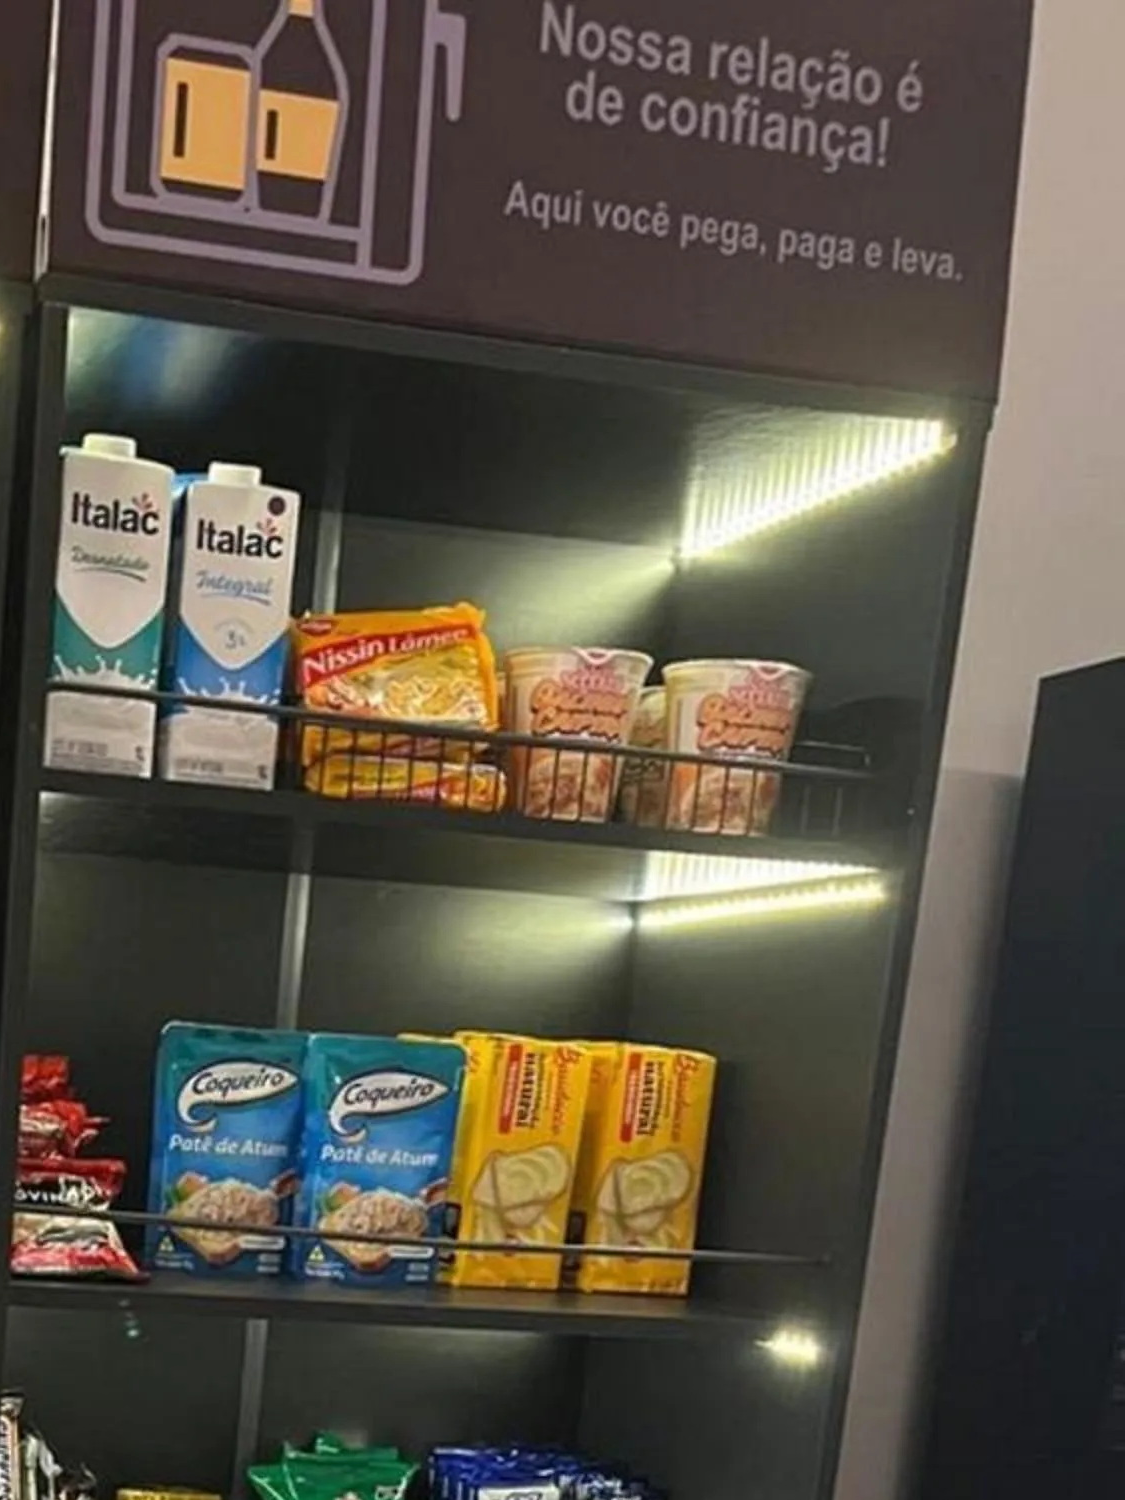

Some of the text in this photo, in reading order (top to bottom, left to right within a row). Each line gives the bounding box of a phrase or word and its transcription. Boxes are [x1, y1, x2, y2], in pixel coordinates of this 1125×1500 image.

[539, 1, 924, 113] Nossa relação é
[565, 70, 892, 173] de confiança!
[503, 180, 964, 282] Aqui você pega, paga e leva.
[71, 491, 160, 536] Italac
[195, 518, 284, 560] Italac
[194, 570, 273, 597] Integral
[301, 638, 385, 684] Nissin
[191, 1067, 286, 1100] Coqueiro
[342, 1079, 437, 1107] Coqueiro
[515, 1051, 536, 1130] natural
[636, 1060, 655, 1138] natural
[213, 1138, 236, 1155] de
[238, 1139, 288, 1158] Atum
[319, 1143, 440, 1168] Patê de Atum
